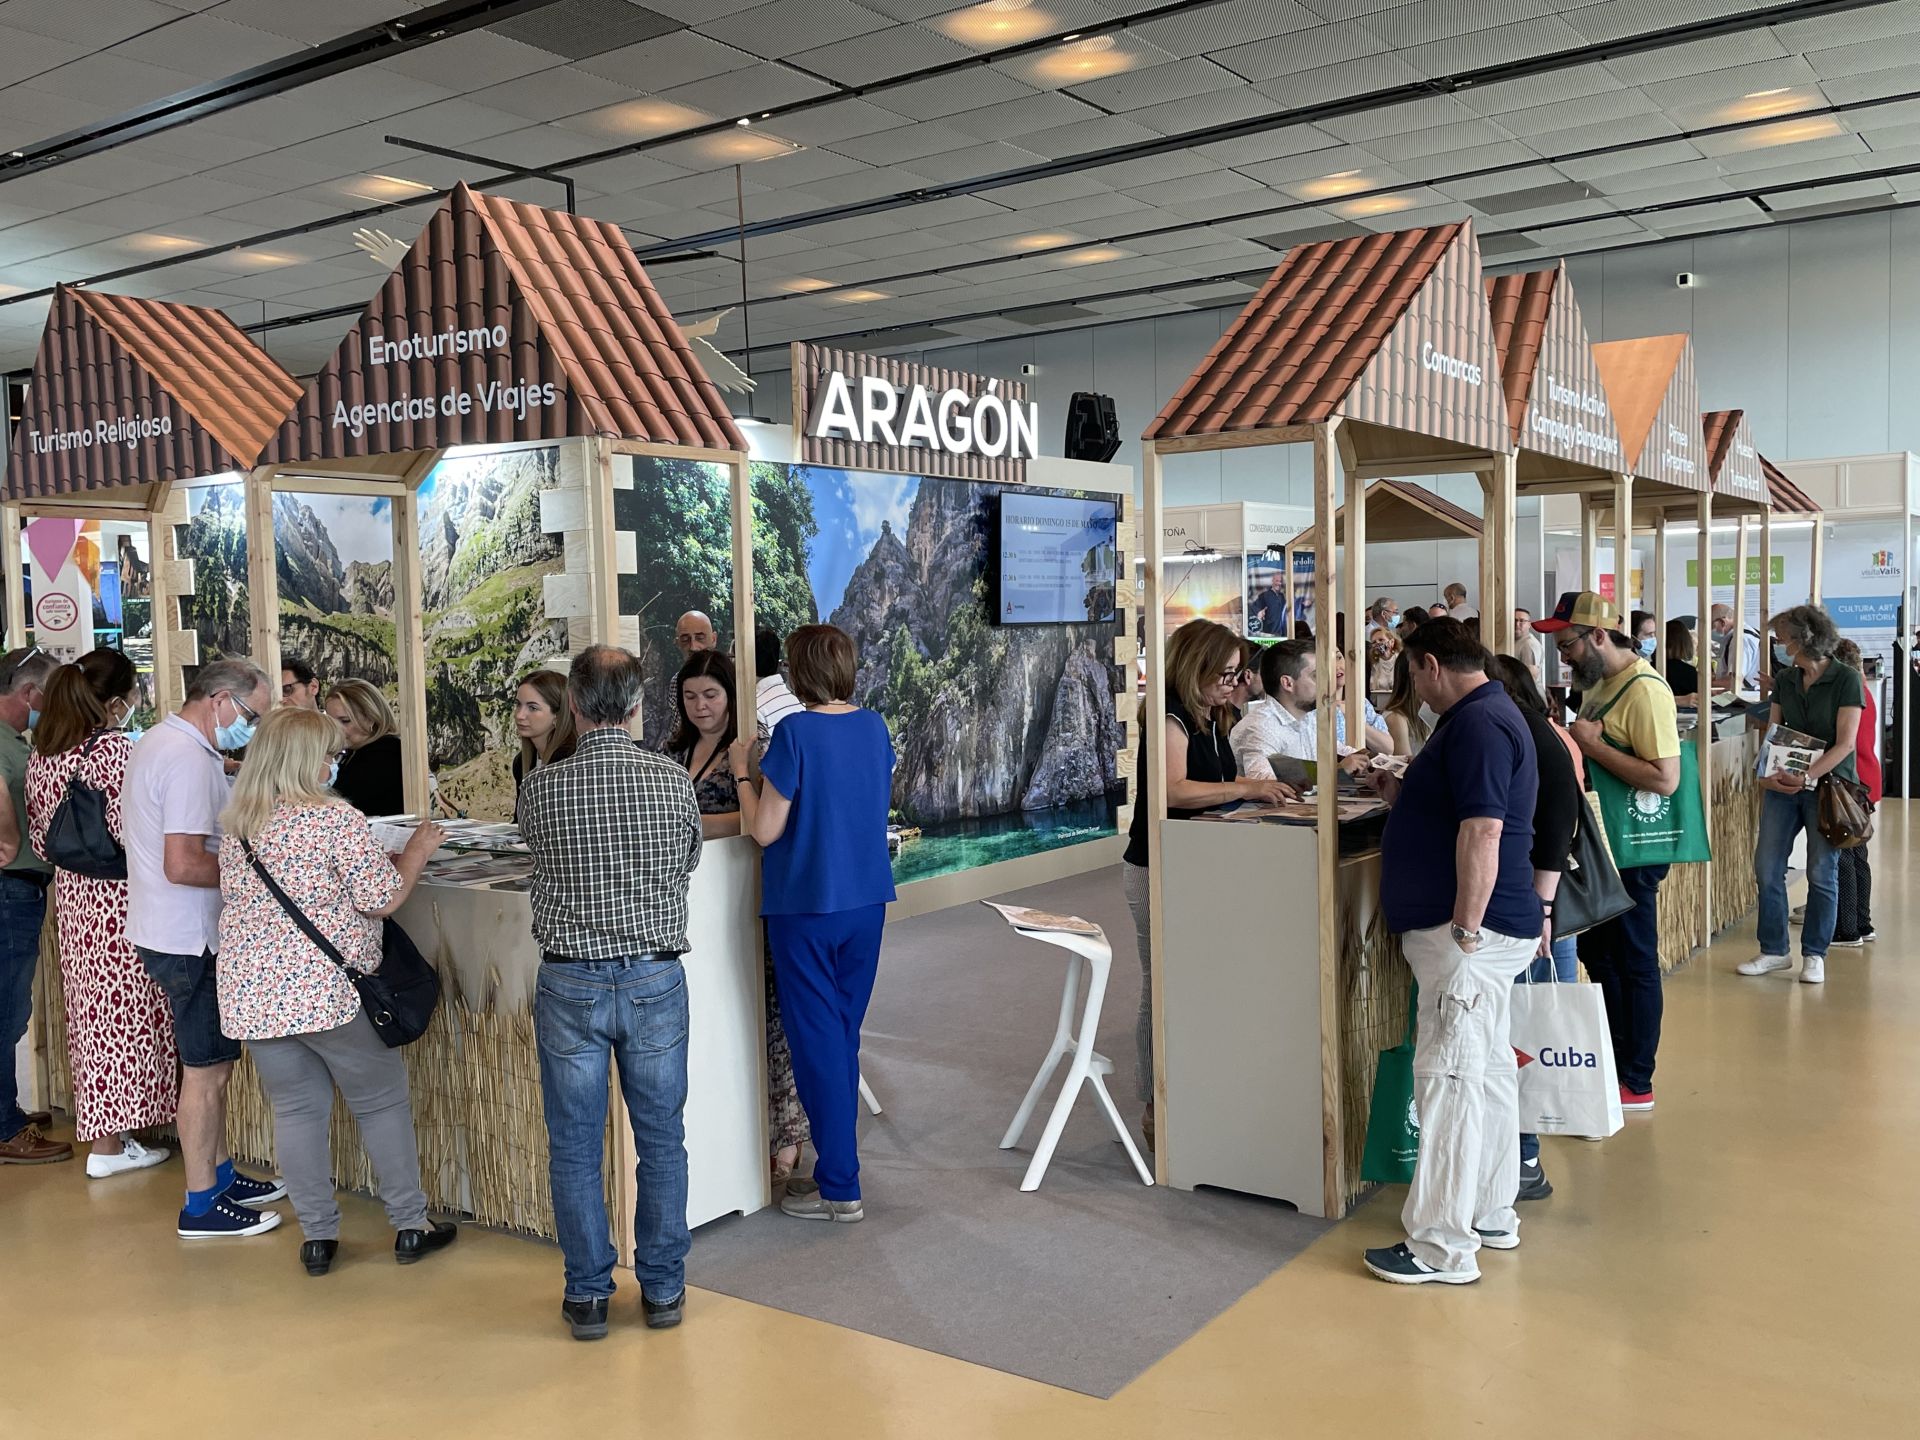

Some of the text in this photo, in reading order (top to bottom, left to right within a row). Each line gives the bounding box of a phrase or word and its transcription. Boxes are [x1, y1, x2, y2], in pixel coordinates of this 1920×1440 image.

[369, 325, 507, 365] Enoturismo
[1423, 341, 1482, 386] Comarcas
[332, 378, 556, 438] Agencias de Viajes
[816, 371, 1038, 460] ARAGÓN
[1548, 376, 1605, 418] Turismo Activo
[30, 414, 172, 454] Turismo Religioso
[1531, 408, 1618, 456] Camping y Bungalows
[1005, 514, 1034, 526] HORARIO
[1035, 516, 1064, 527] DOMINGO
[1163, 527, 1186, 537] TOÑA
[1879, 604, 1893, 612] ART
[1628, 796, 1670, 823] CINCOVILL
[1539, 1046, 1597, 1068] Cuba
